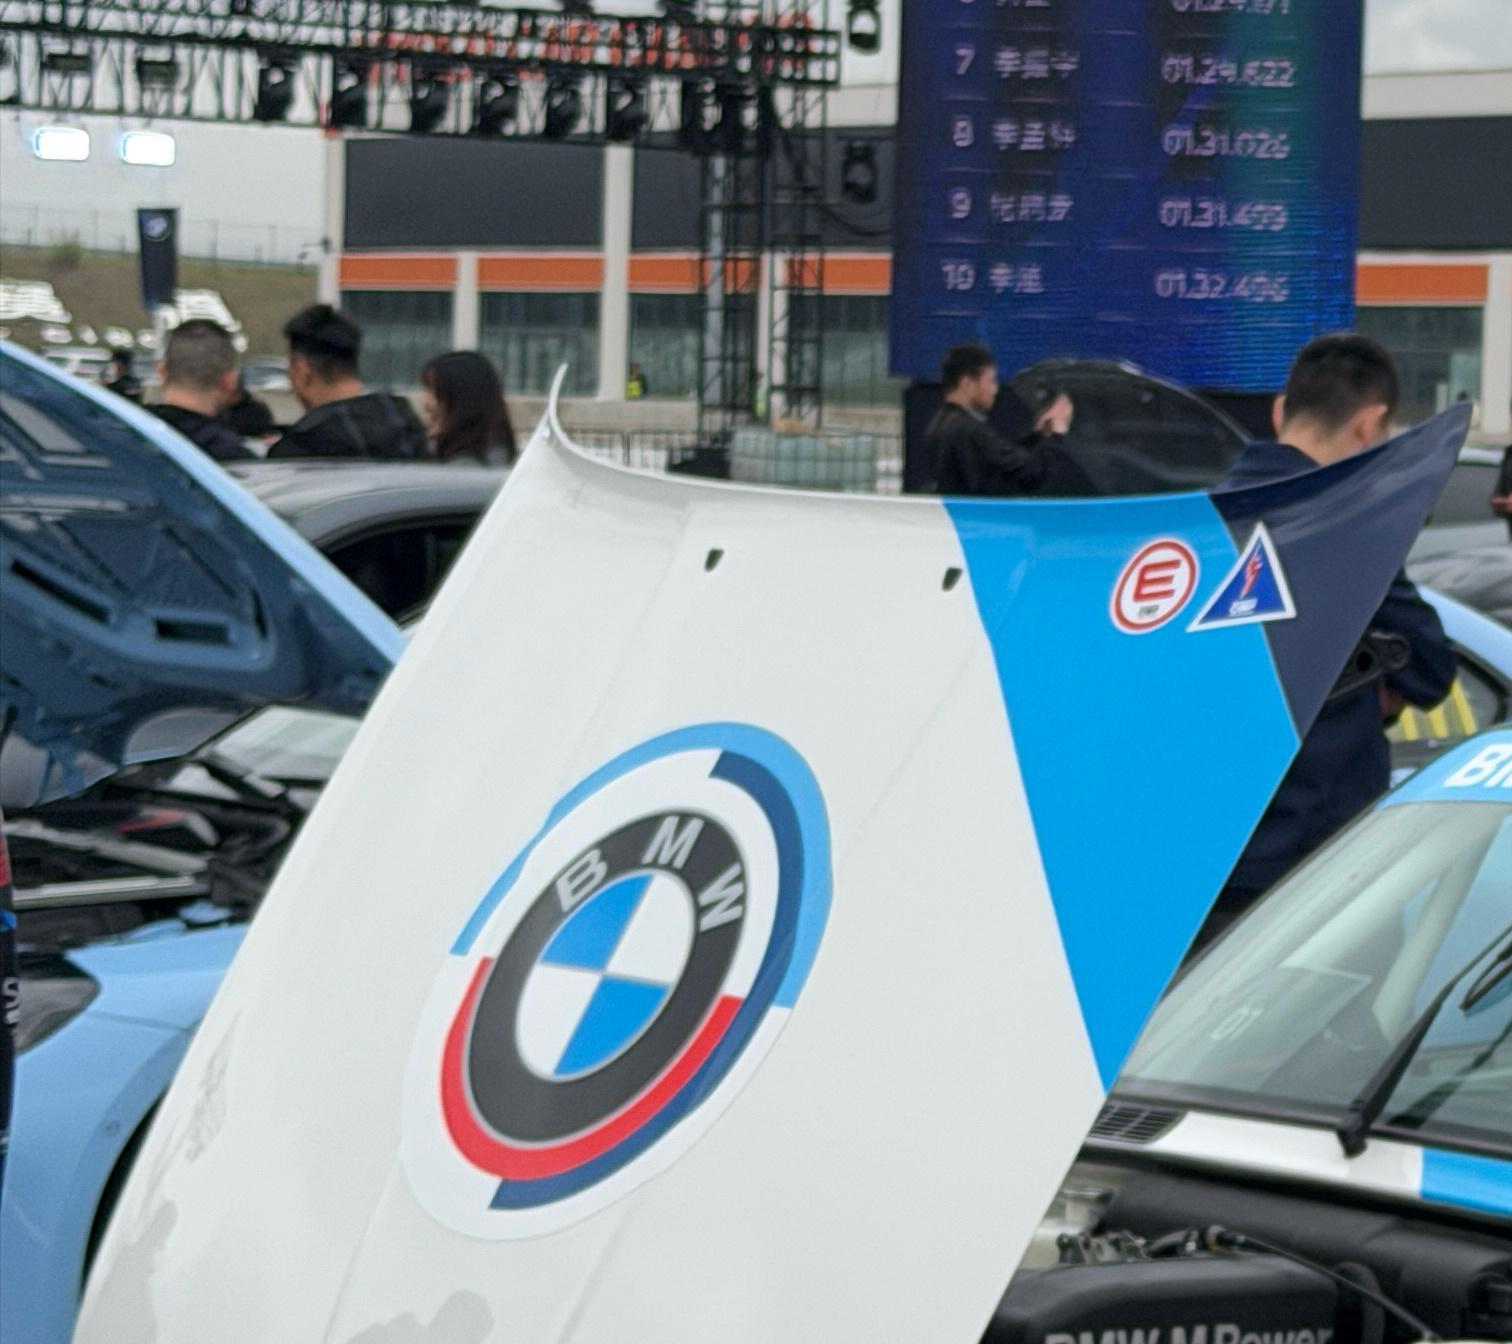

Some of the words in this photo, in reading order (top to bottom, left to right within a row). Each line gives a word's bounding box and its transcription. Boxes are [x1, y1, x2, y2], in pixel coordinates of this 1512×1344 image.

[955, 47, 975, 75] 7
[953, 118, 974, 147] 8
[951, 189, 971, 219] 9
[942, 260, 975, 290] 10
[553, 814, 744, 932] BMW
